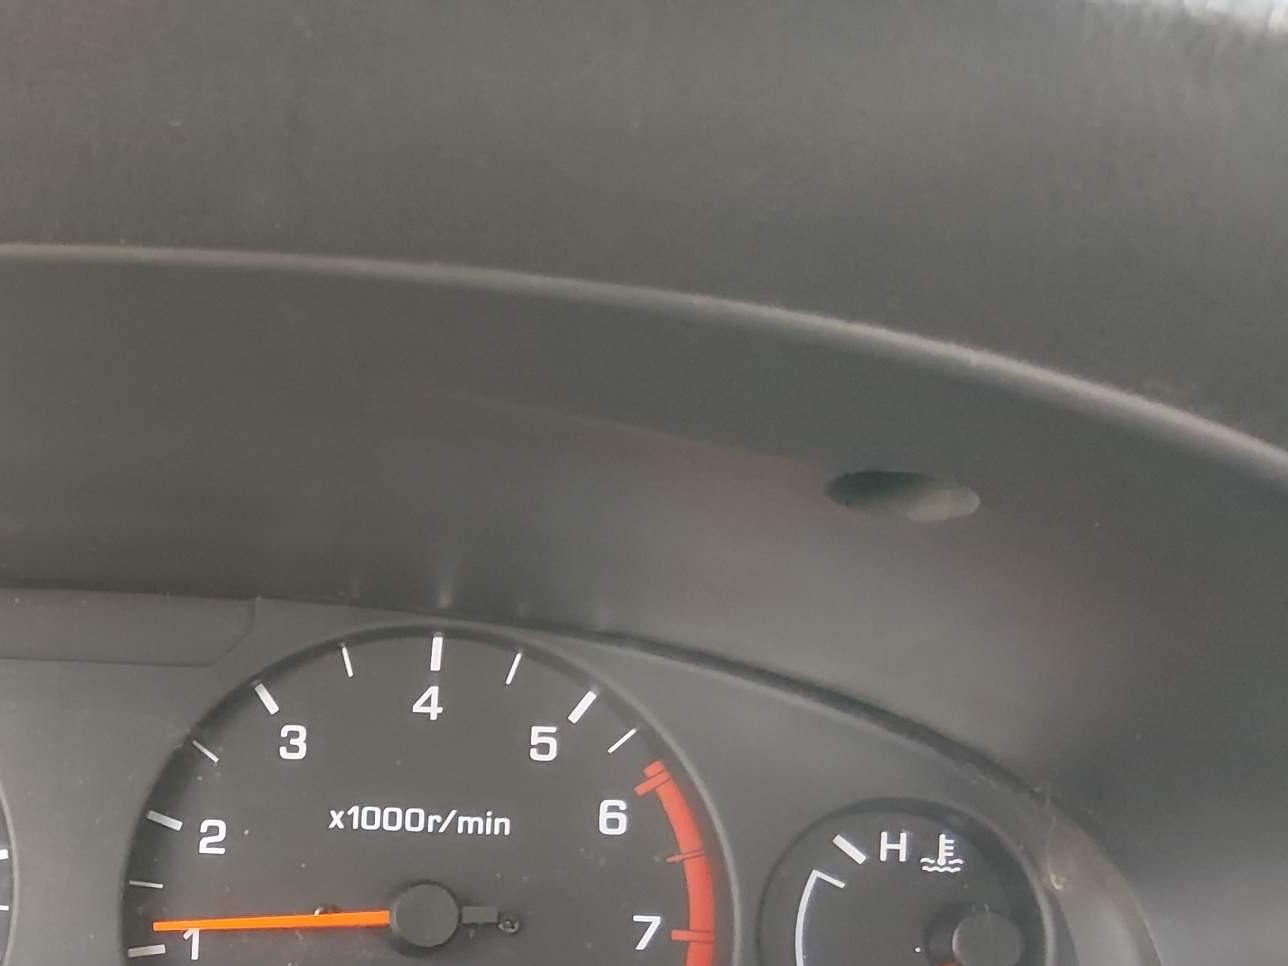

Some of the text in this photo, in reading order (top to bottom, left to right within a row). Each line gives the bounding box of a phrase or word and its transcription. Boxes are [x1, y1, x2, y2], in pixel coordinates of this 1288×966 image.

[412, 686, 443, 720] 4
[279, 725, 307, 760] 3
[529, 726, 557, 761] 5
[598, 800, 627, 836] 6
[199, 819, 226, 854] 2
[880, 831, 907, 862] H
[183, 928, 199, 960] 1
[633, 915, 661, 951] 7
